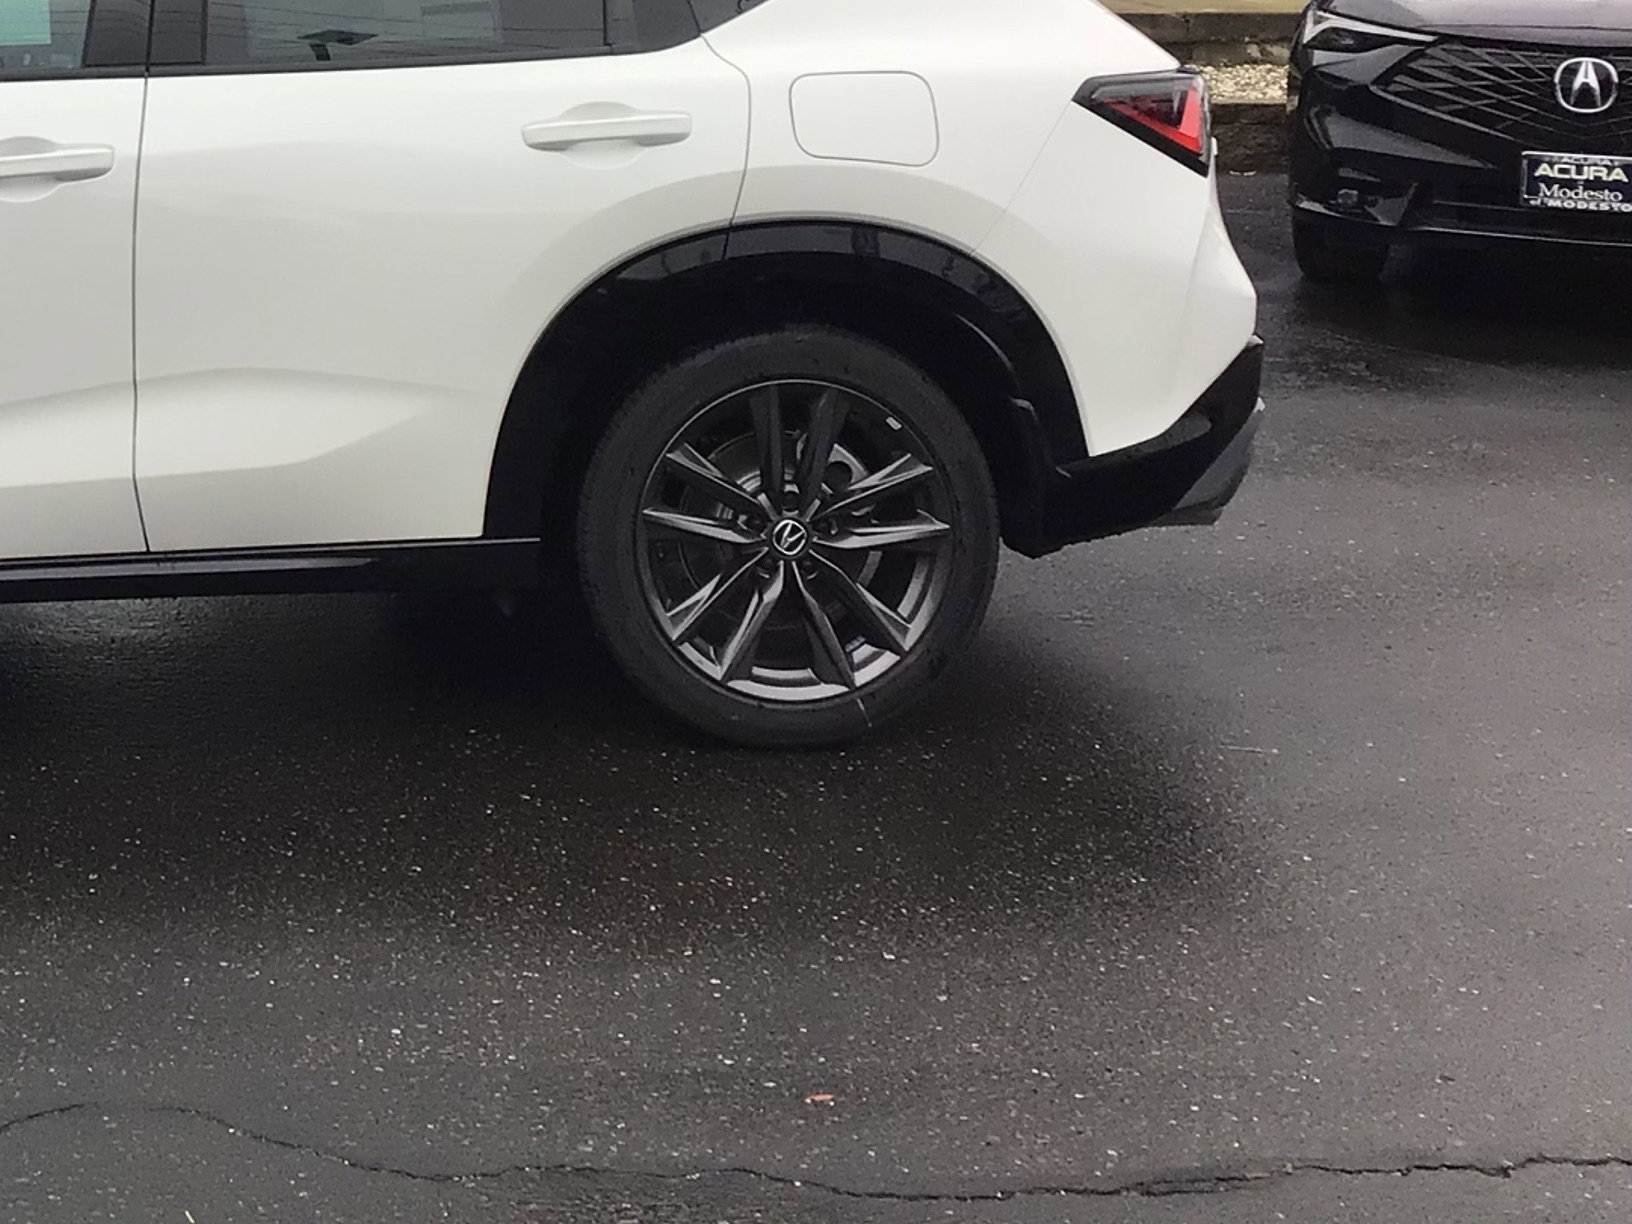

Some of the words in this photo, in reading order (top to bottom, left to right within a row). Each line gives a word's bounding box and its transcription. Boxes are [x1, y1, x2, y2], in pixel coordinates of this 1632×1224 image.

[1534, 163, 1629, 183] ACURA
[1537, 182, 1623, 201] Modesto
[1547, 199, 1632, 212] MODESTO
